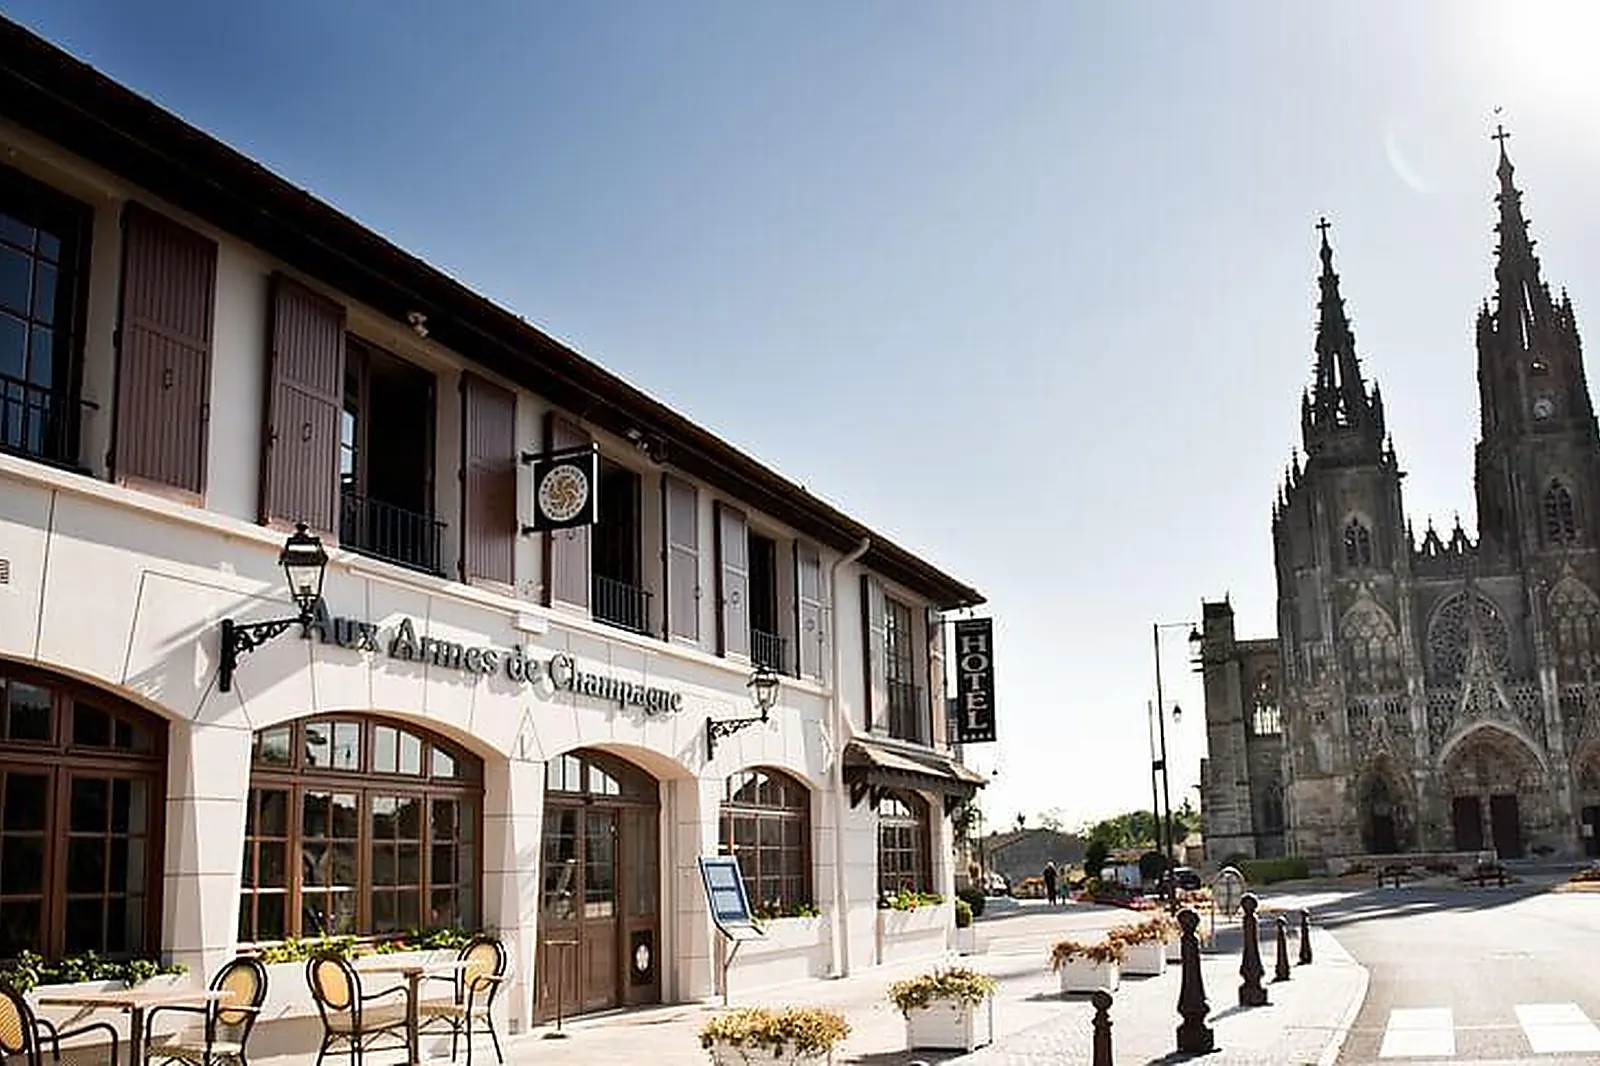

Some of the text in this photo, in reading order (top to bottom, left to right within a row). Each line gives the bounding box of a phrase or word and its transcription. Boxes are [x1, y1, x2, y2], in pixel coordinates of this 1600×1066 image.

[307, 597, 683, 714] Aux Armes de Champagne
[961, 635, 989, 729] HOTEL
